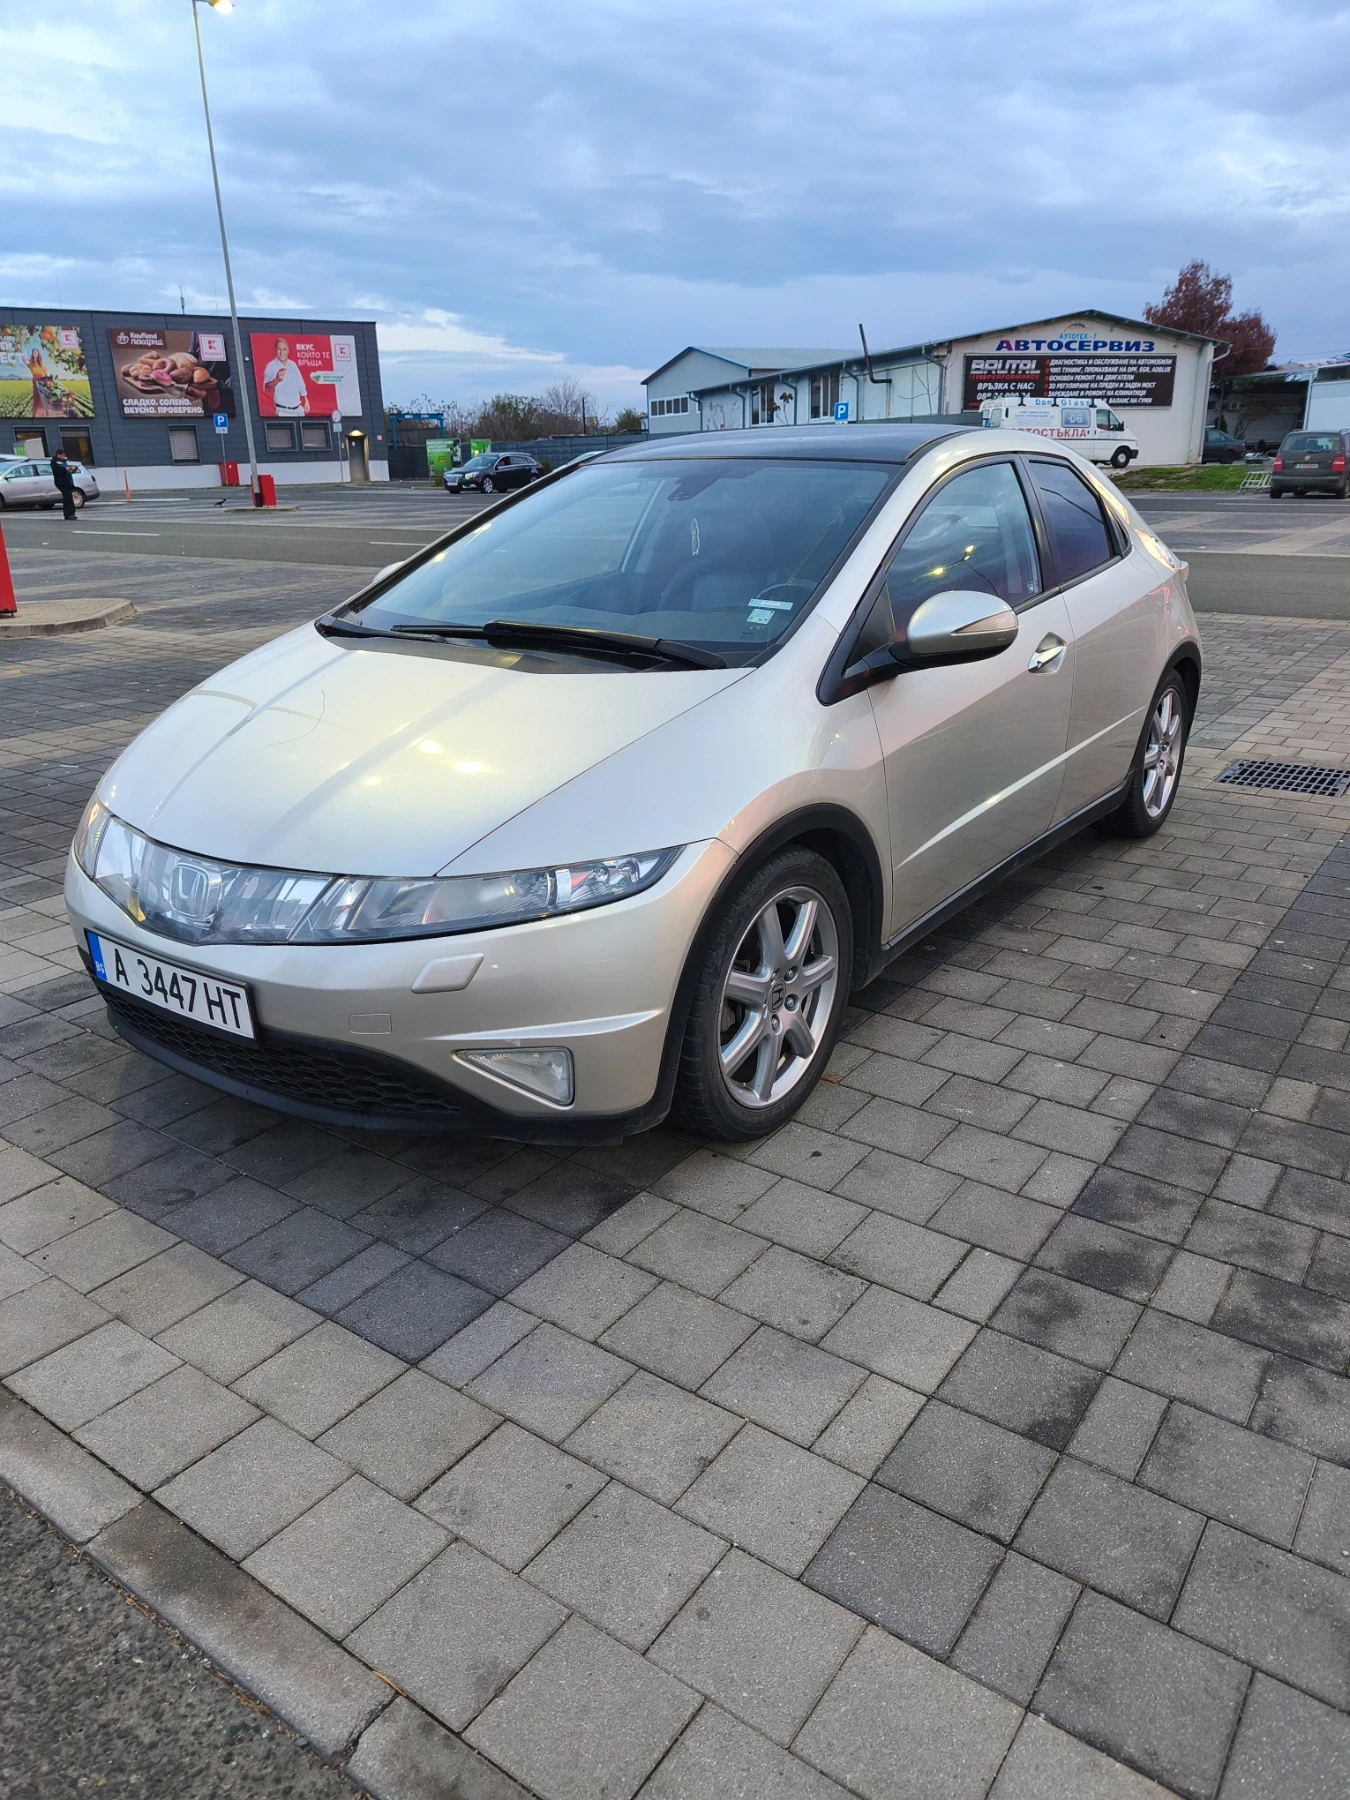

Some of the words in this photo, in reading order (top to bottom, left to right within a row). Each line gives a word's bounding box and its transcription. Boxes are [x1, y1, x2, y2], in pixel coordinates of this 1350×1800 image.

[995, 340, 1155, 352] АВТОСЕРВИЗ
[297, 351, 321, 359] КОЙТО
[298, 359, 324, 367] ВРЪЩА
[970, 360, 1041, 374] BRUTAL
[1060, 398, 1091, 406] Glass
[838, 405, 846, 419] P
[217, 415, 225, 426] P
[1013, 427, 1087, 438] ОСТЪКЛА
[94, 960, 105, 974] BG
[137, 958, 197, 1013] 3447
